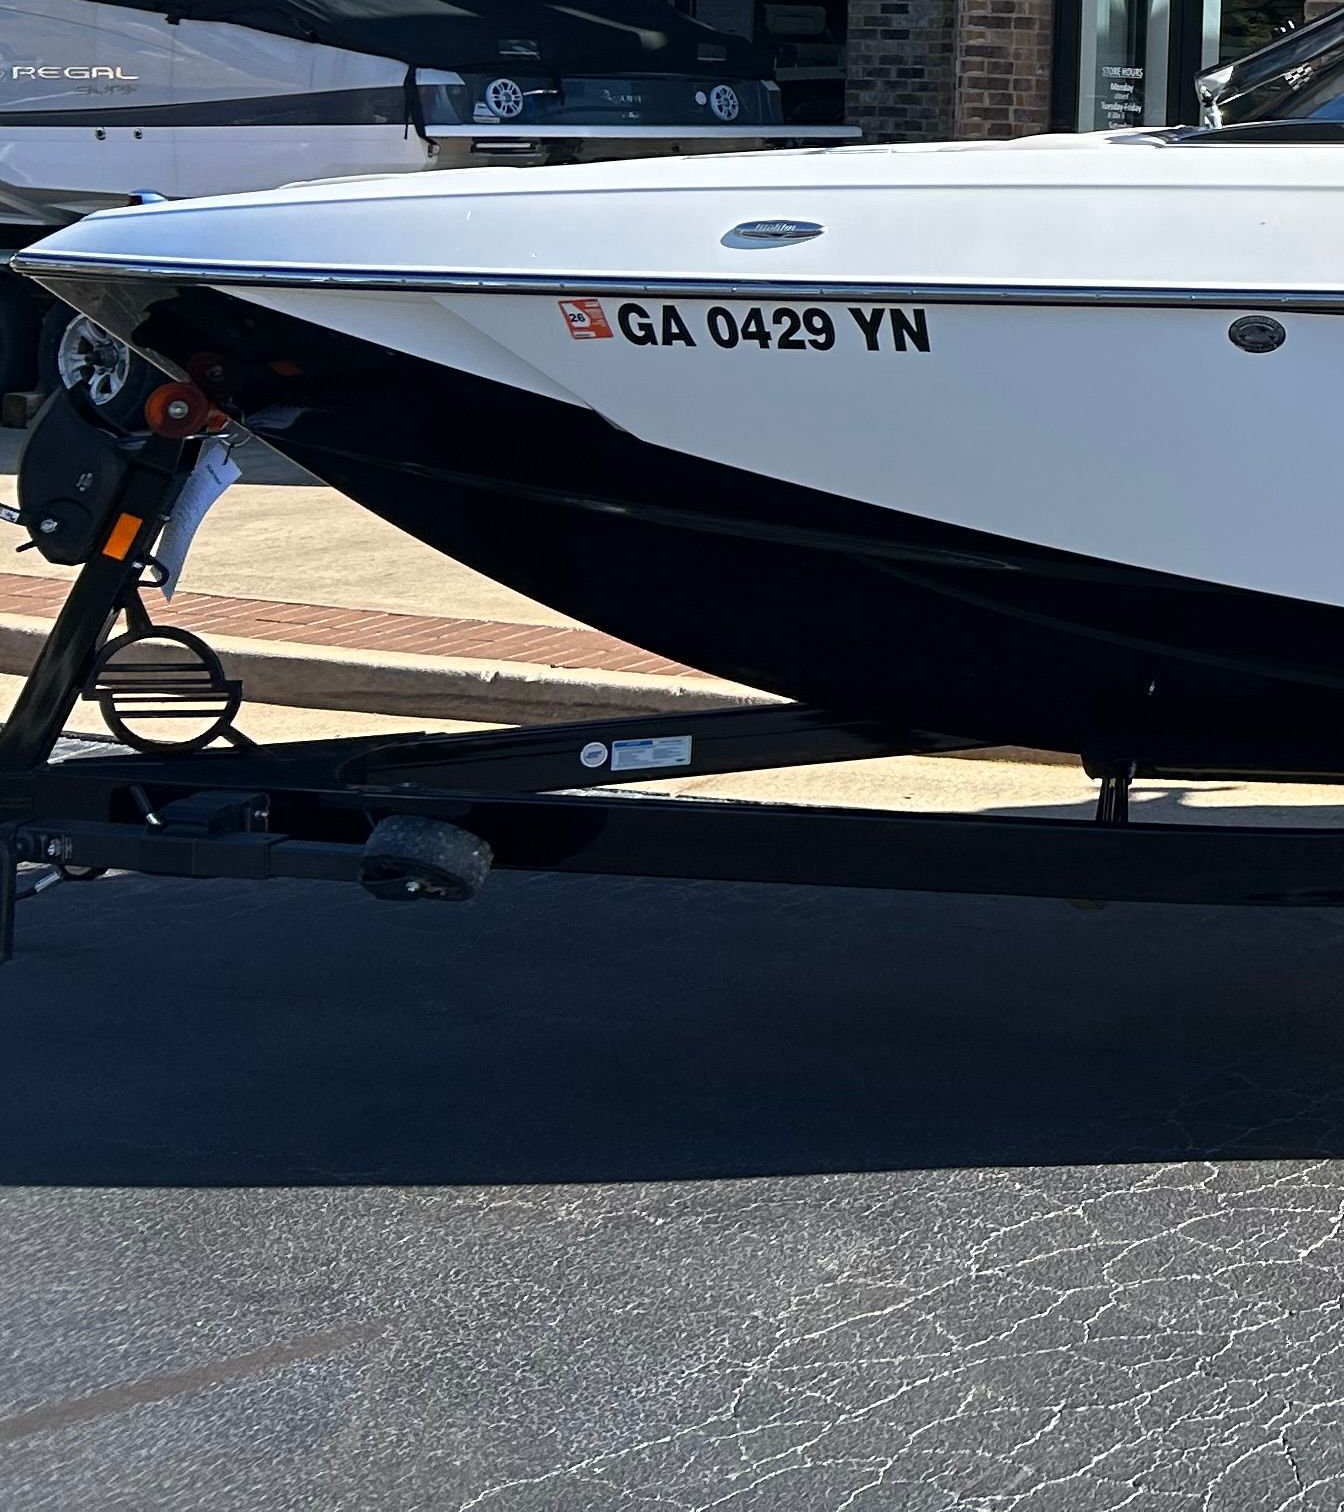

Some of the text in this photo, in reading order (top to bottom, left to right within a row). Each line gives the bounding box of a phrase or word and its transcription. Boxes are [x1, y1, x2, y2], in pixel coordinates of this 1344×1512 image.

[12, 66, 140, 80] REGAL
[569, 313, 586, 323] 26
[617, 302, 697, 347] GA
[706, 306, 836, 351] 0429
[847, 307, 931, 352] YN
